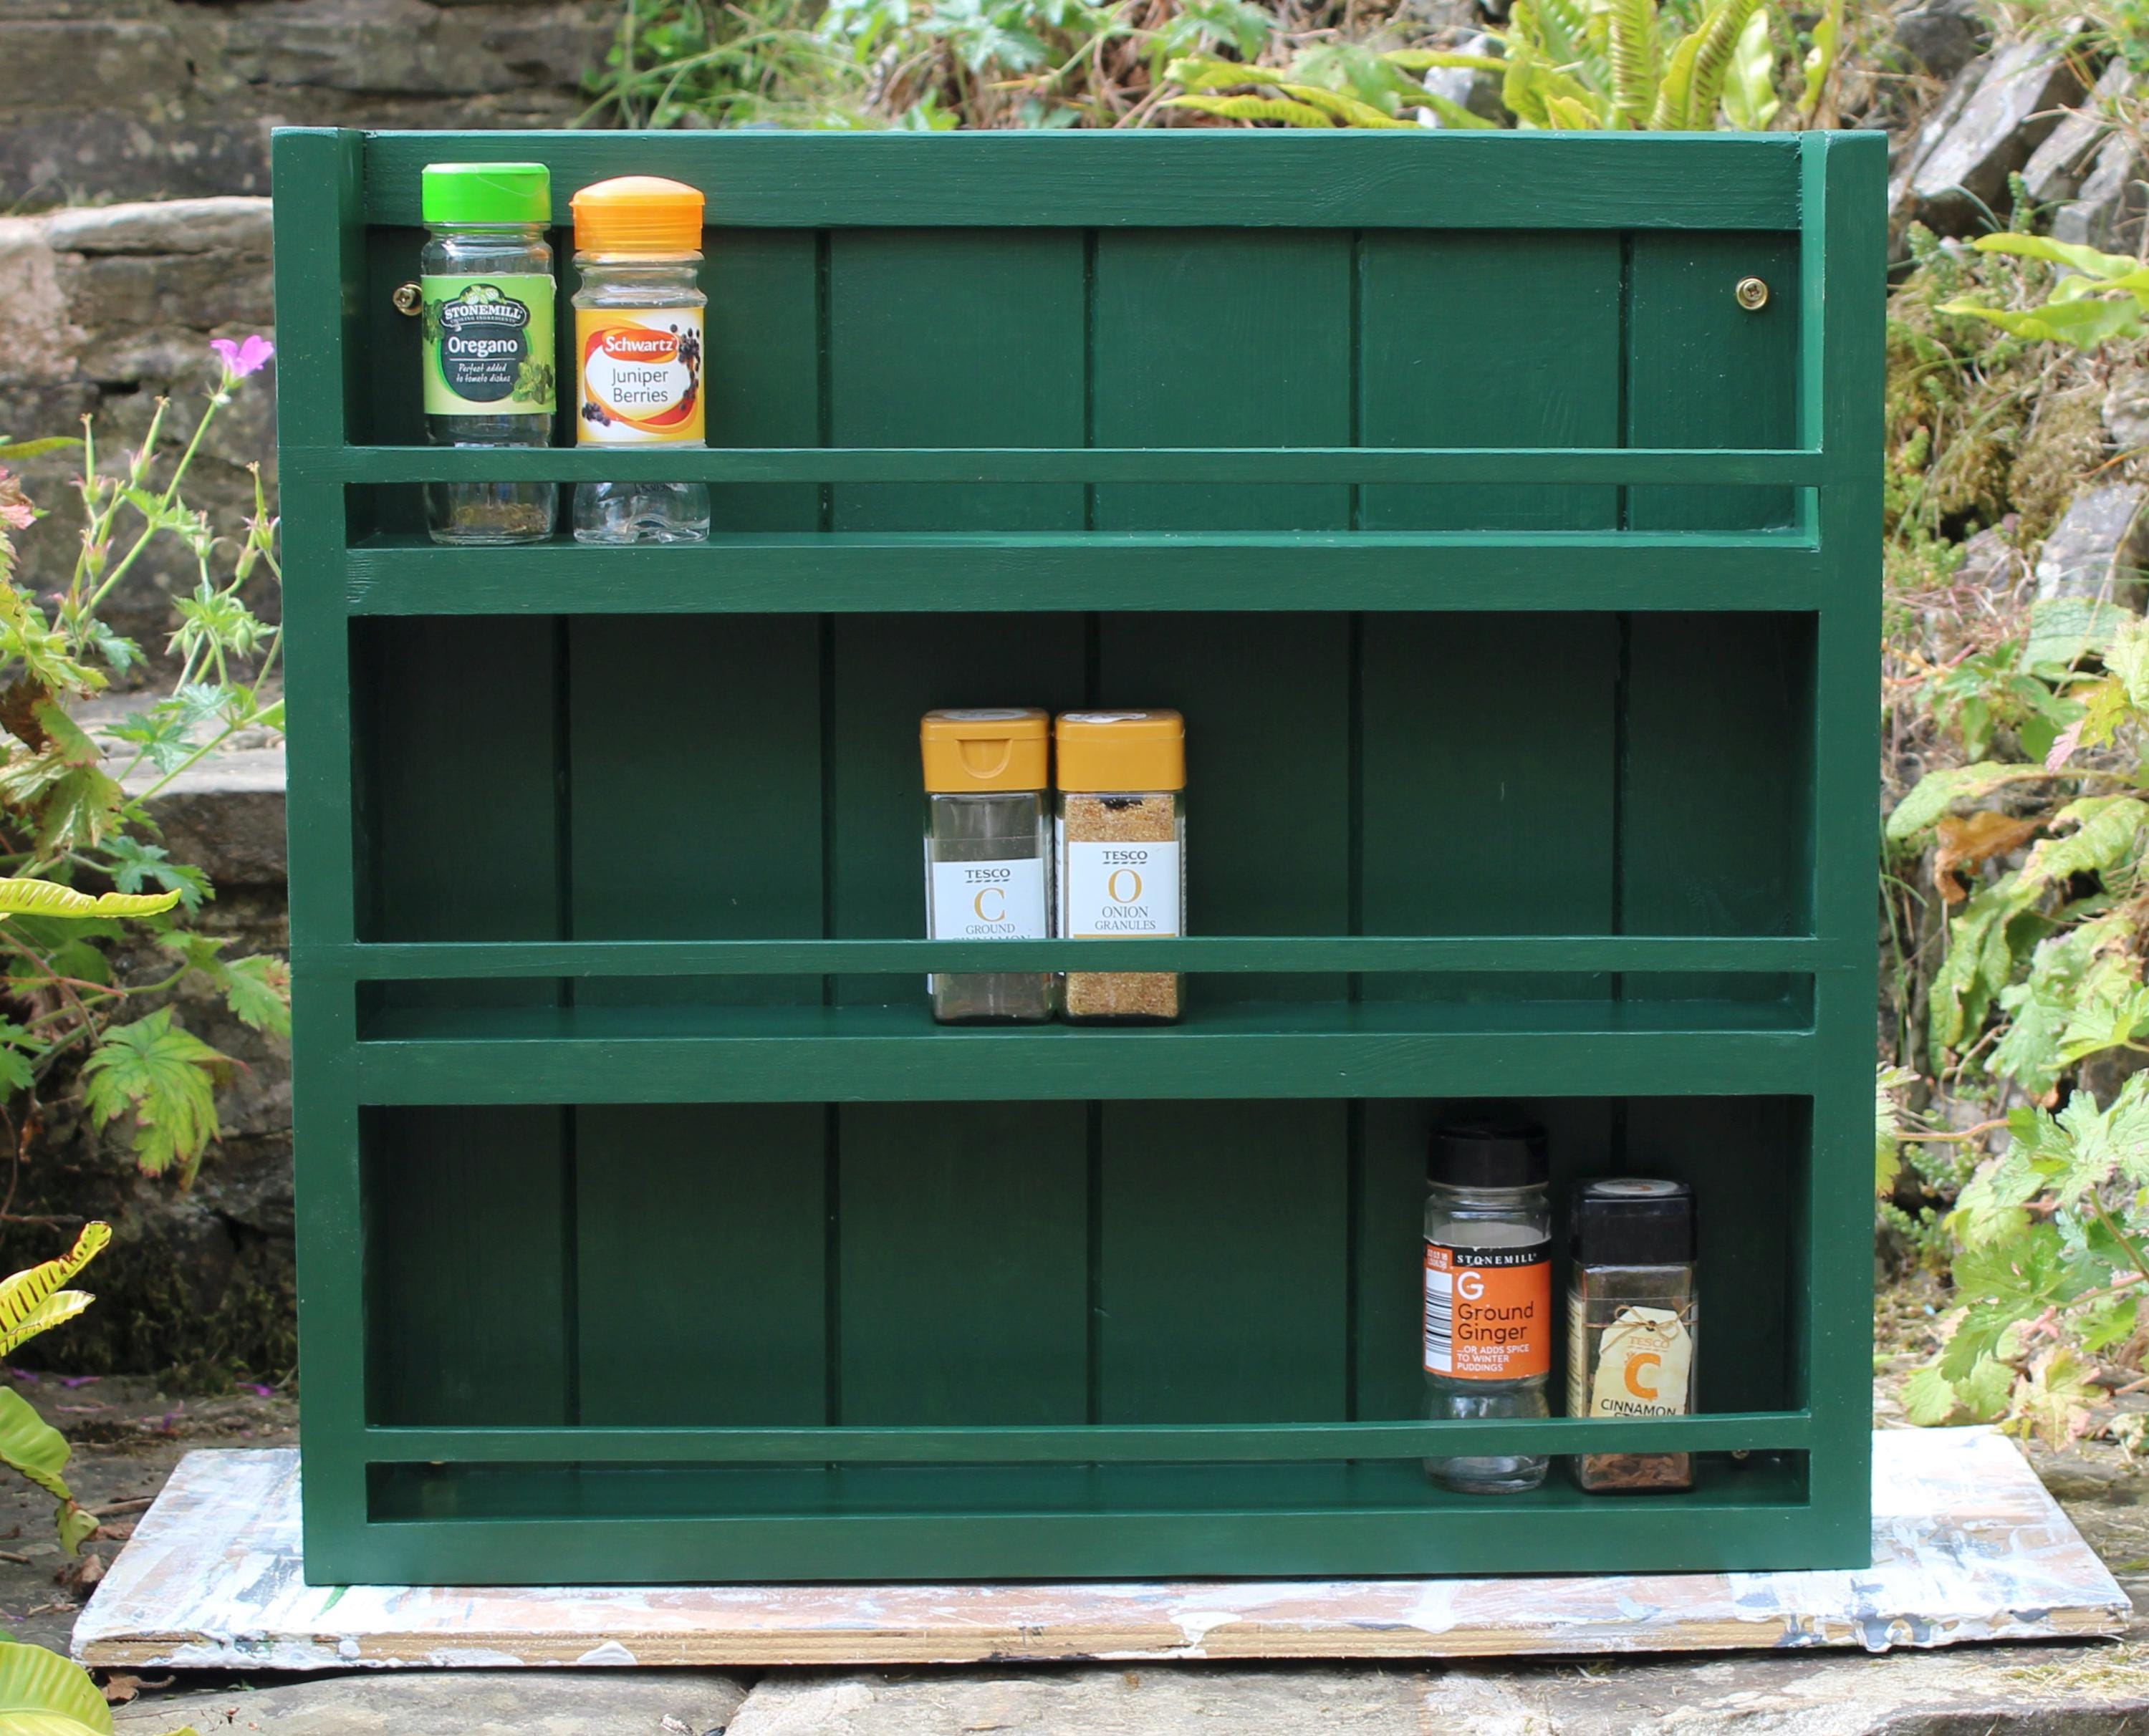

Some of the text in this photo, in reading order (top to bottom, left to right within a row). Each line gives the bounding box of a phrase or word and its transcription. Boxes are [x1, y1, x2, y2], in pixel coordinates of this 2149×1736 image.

[445, 304, 521, 320] STONEMILL
[448, 337, 518, 357] Oregano
[605, 336, 673, 352] Schwartz
[458, 363, 507, 375] Perfect added
[456, 373, 511, 382] to tomato dishes
[612, 367, 668, 387] Juniper
[613, 387, 668, 402] Berries
[1102, 851, 1148, 860] TESCO
[965, 869, 1010, 879] TESCO
[1108, 868, 1142, 903] O
[974, 887, 1006, 922] C
[1102, 906, 1148, 918] ONION
[966, 924, 1015, 935] GROUND
[1095, 920, 1155, 930] GRANULES
[1457, 1253, 1534, 1265] STONEMILL
[1457, 1271, 1484, 1300] G
[1458, 1301, 1534, 1321] Ground
[1458, 1323, 1527, 1344] Ginger
[1480, 1345, 1504, 1354] ADDS
[1507, 1344, 1529, 1353] SPICE
[1630, 1336, 1670, 1349] TESCO
[1457, 1354, 1509, 1363] TO WINTER
[1457, 1363, 1503, 1371] PUDDINGS
[1625, 1352, 1661, 1401] C
[1600, 1399, 1676, 1416] CINNAMON
